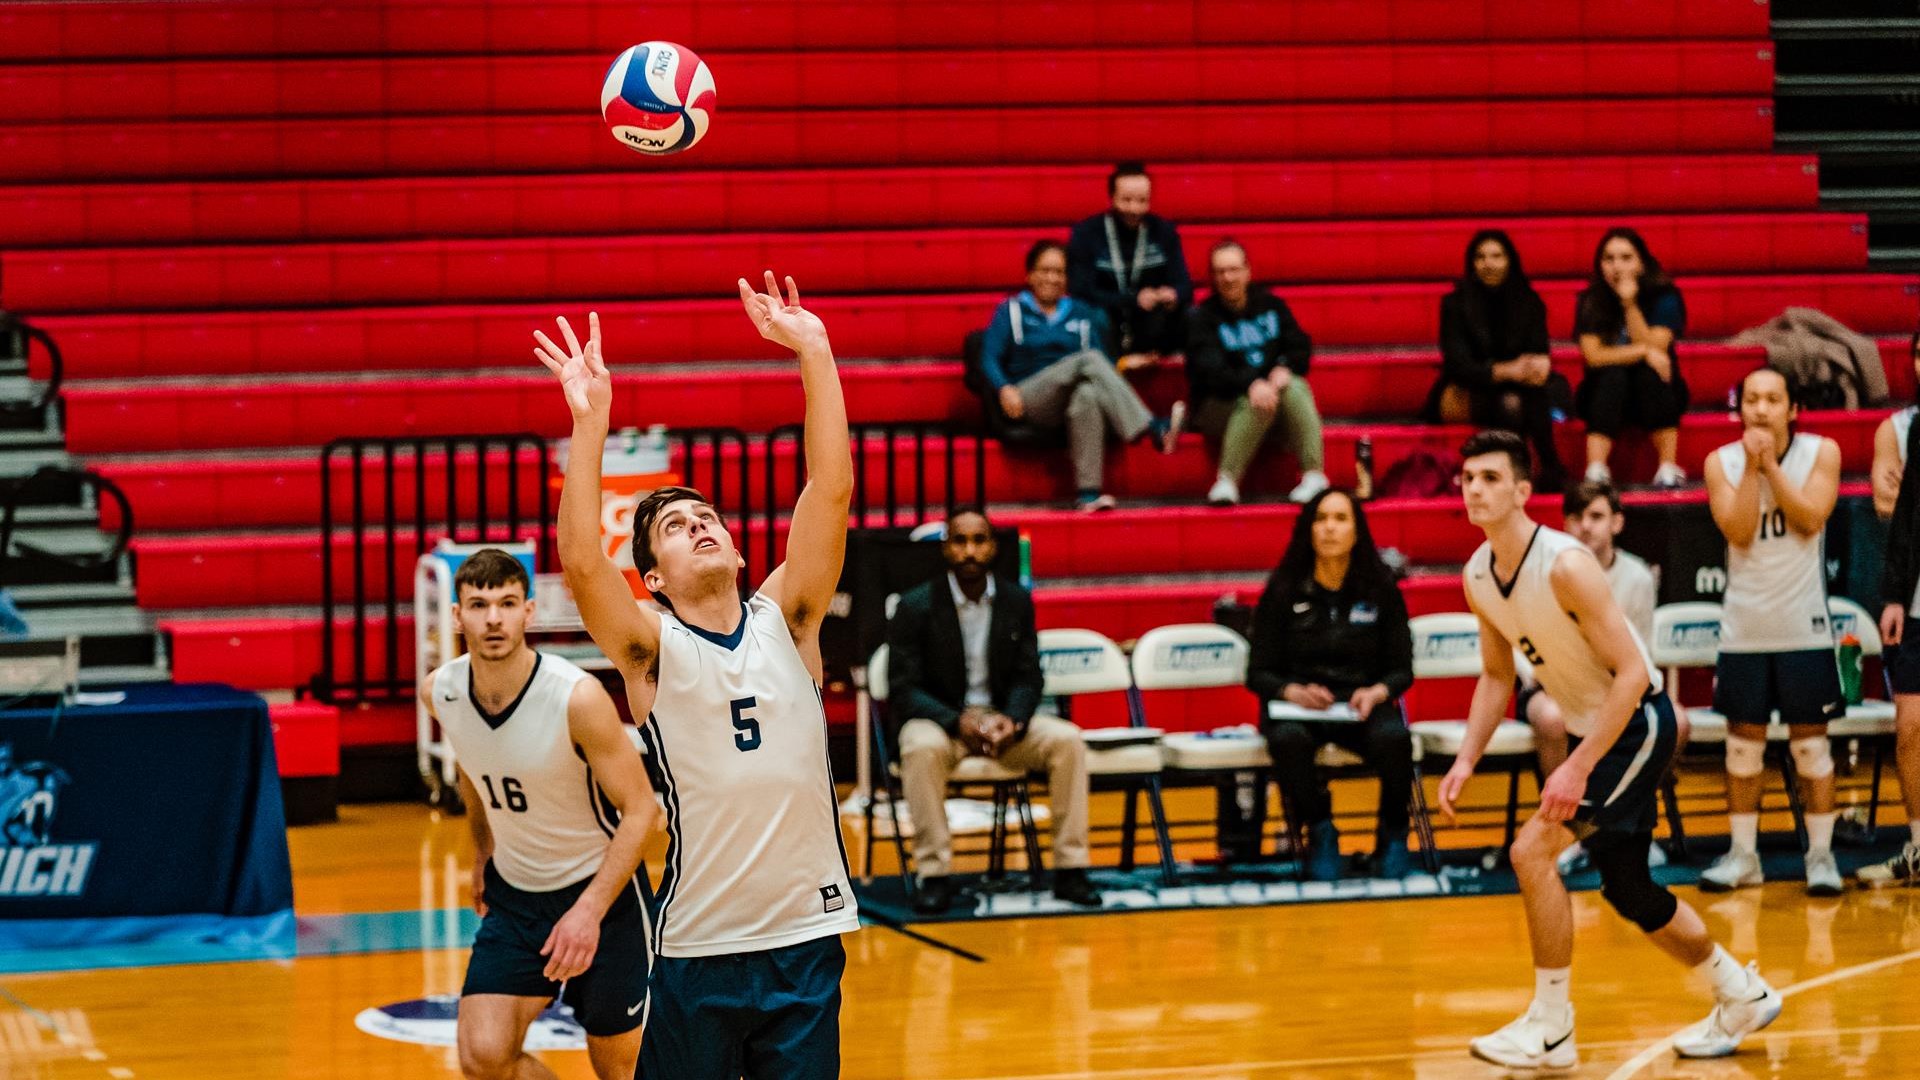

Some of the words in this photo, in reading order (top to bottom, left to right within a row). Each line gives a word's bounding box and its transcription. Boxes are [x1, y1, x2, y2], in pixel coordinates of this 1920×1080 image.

[625, 131, 665, 147] NCAA
[1760, 508, 1786, 539] 10
[1520, 636, 1545, 666] 2
[730, 696, 762, 752] 5
[481, 774, 528, 813] 16
[826, 887, 836, 897] M
